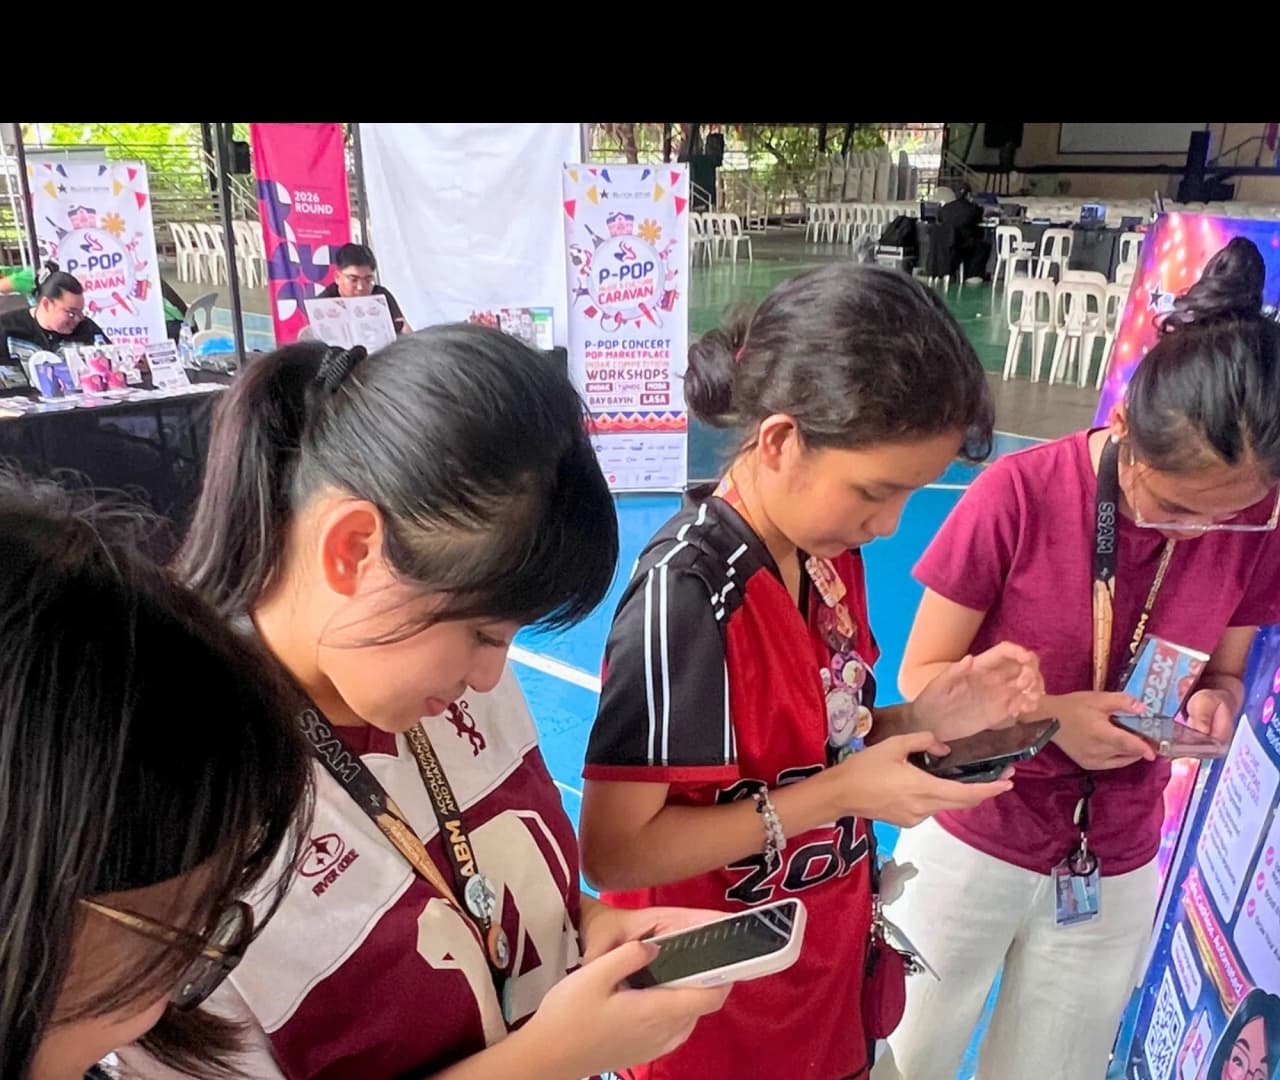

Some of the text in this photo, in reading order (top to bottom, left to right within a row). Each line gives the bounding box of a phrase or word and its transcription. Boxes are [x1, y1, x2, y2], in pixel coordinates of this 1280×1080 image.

[293, 190, 320, 203] 2026
[295, 202, 334, 215] ROUND
[67, 252, 123, 273] P-POP
[599, 260, 654, 285] P-POP
[597, 286, 654, 305] CARAVAN
[584, 339, 671, 350] P-POP CONCERT
[585, 350, 670, 359] POP MARKETPLACE
[585, 368, 670, 381] WORKSHOPS
[1096, 500, 1116, 554] SSAM
[299, 707, 362, 785] SSAM
[439, 787, 458, 813] AND
[444, 818, 477, 879] ABM
